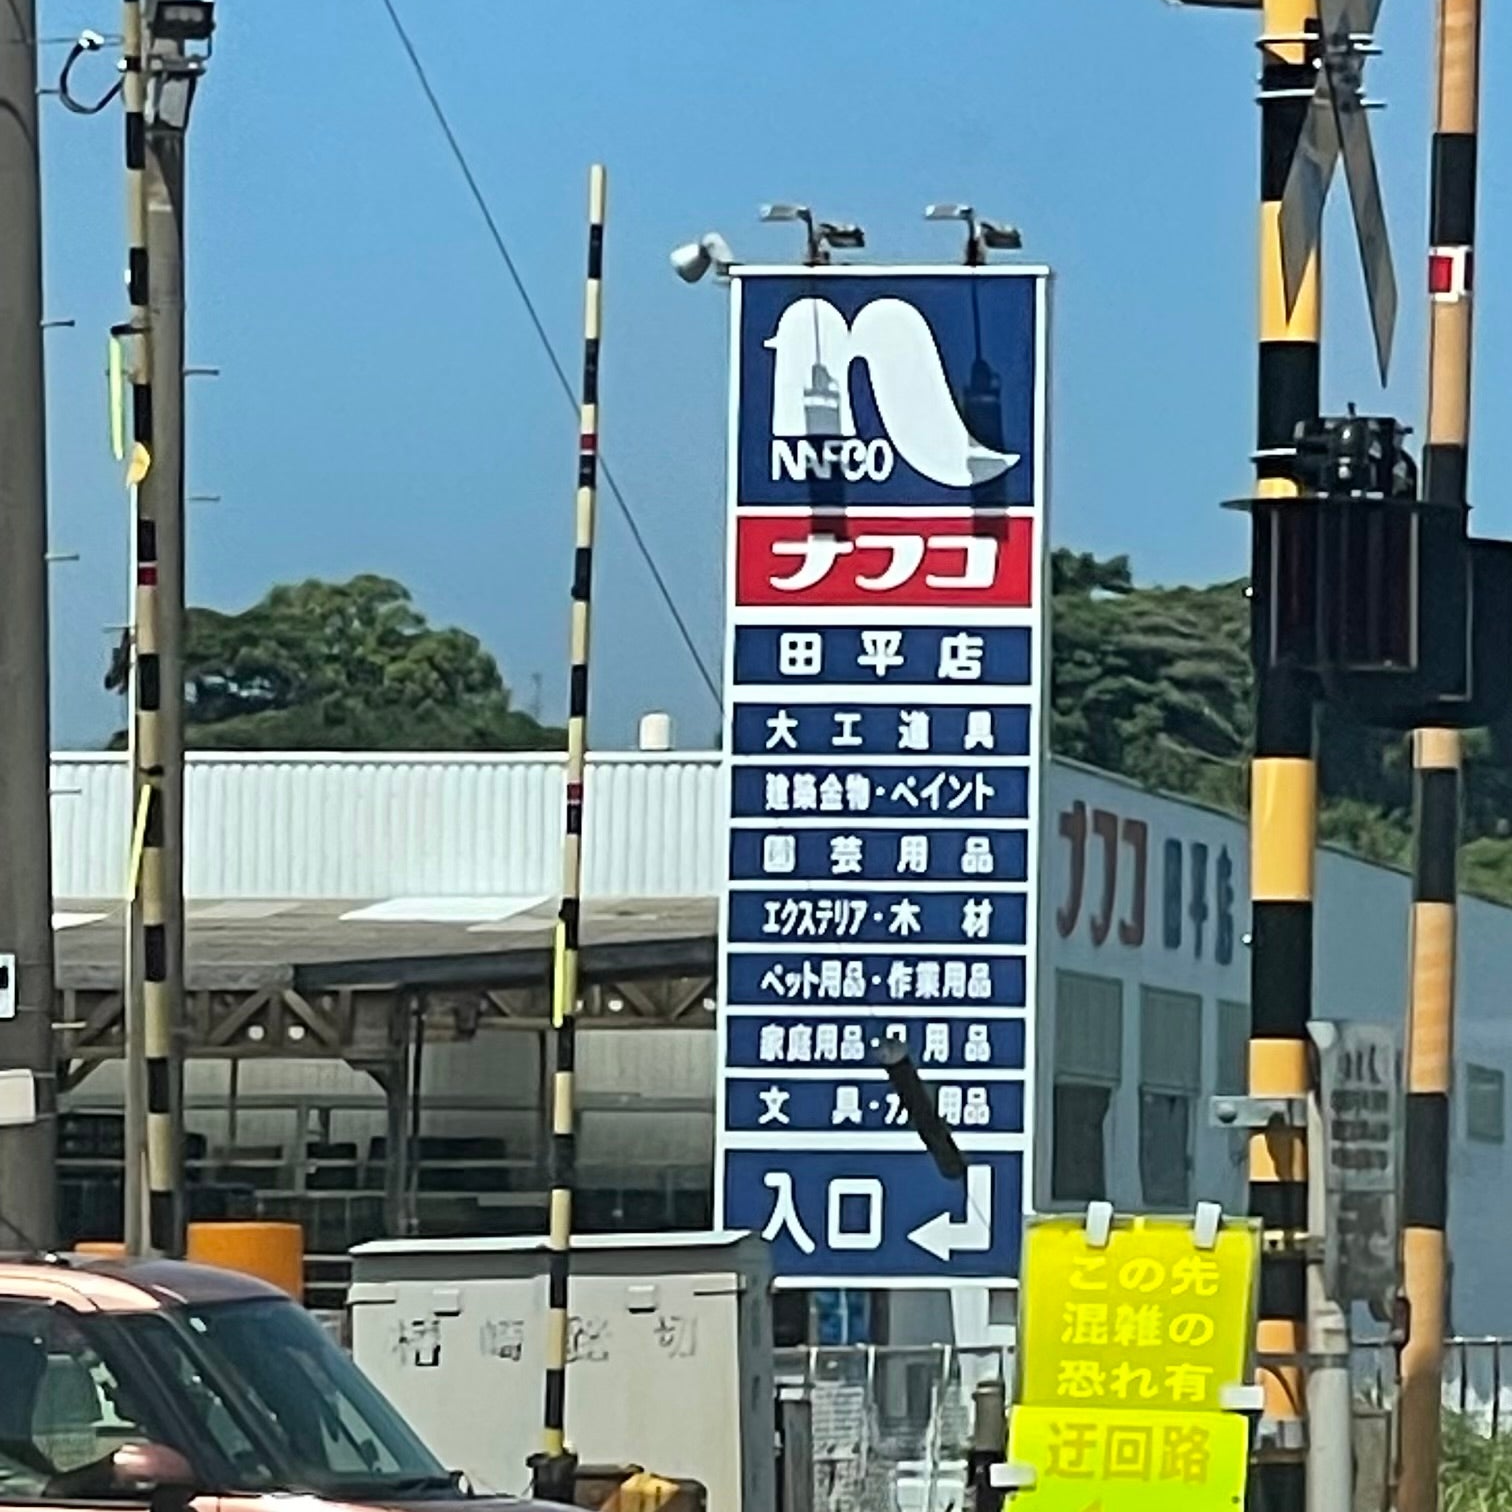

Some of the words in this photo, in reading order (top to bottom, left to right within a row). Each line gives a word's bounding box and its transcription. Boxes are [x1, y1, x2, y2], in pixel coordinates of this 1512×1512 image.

[772, 439, 894, 481] NAFCO
[770, 534, 998, 591] ナフコ
[779, 631, 984, 679] 田平店
[766, 709, 994, 750] 大工道具
[762, 1172, 884, 1255] 入口
[1069, 1255, 1220, 1296] この先
[1061, 1302, 1214, 1347] 混雑の
[1057, 1359, 1213, 1401] 恐れ有
[1044, 1423, 1212, 1484] 迂回路
